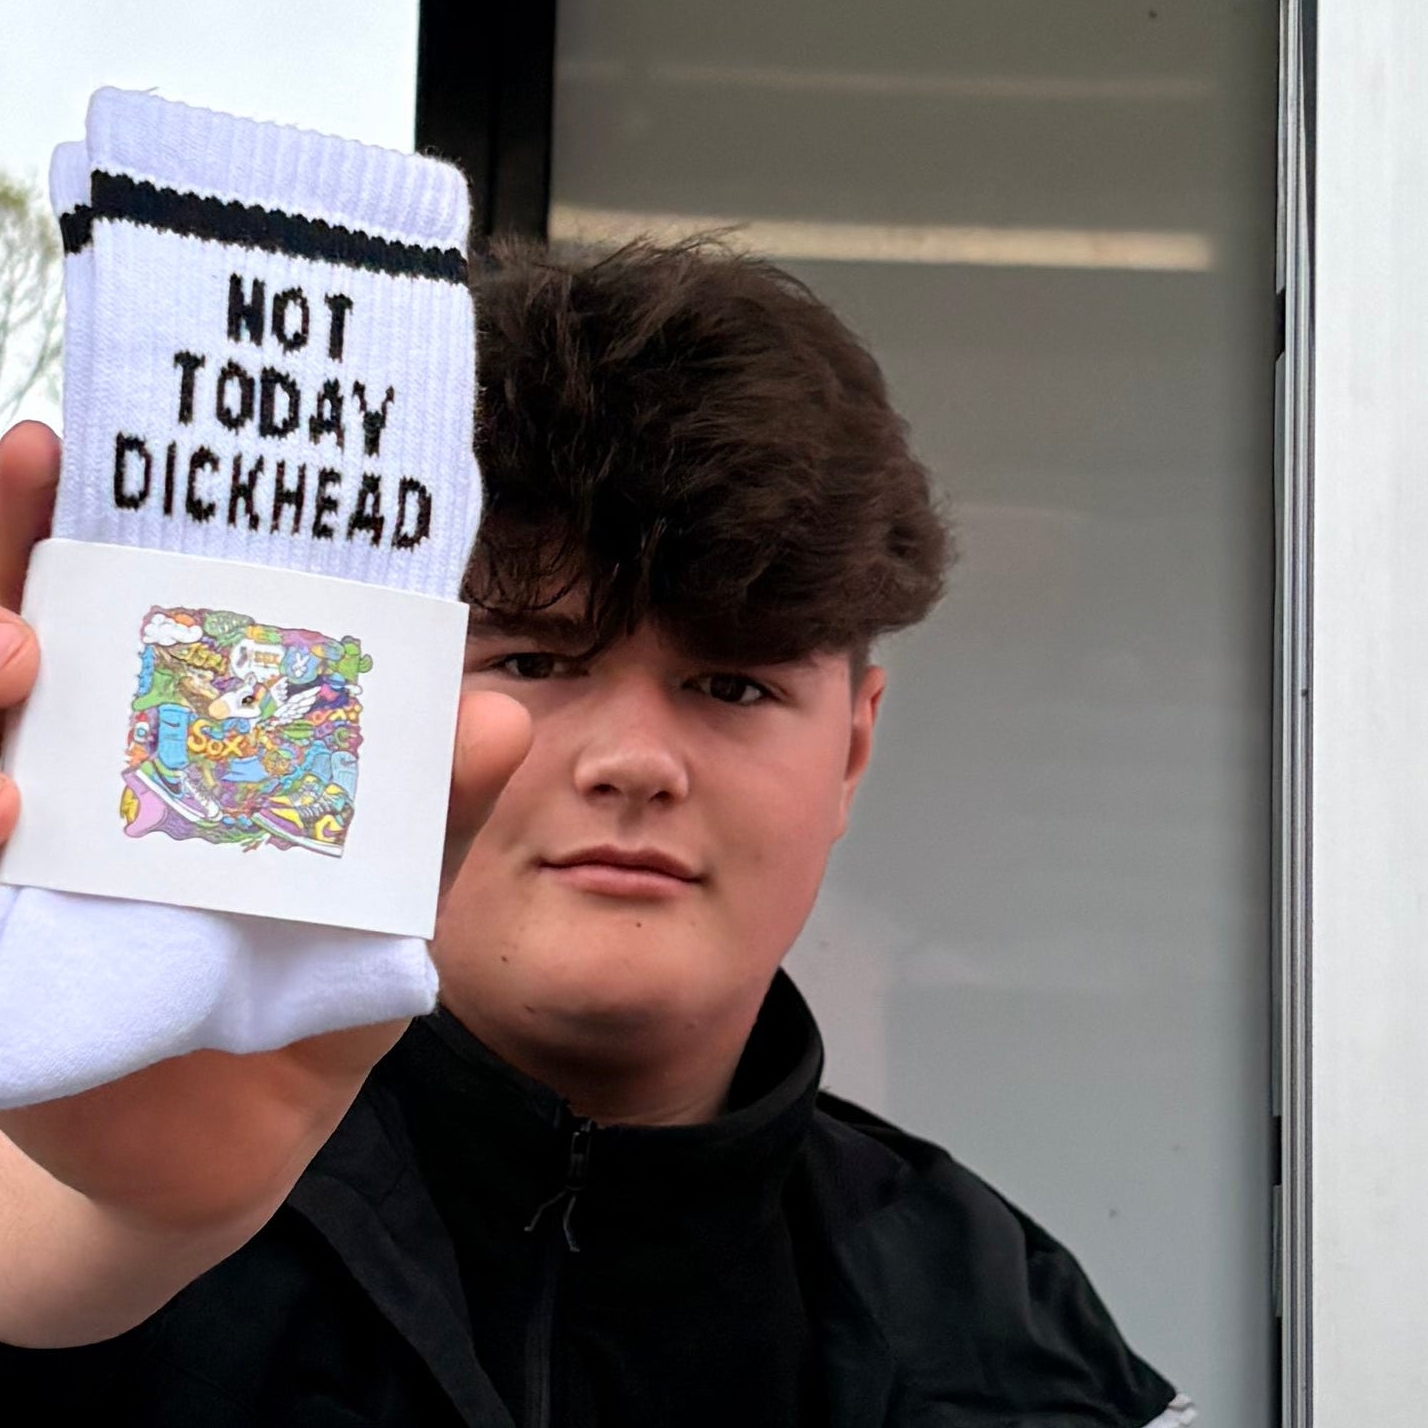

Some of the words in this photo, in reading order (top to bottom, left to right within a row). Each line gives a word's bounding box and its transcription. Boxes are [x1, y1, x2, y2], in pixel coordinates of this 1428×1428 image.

[227, 272, 353, 363] NOT
[173, 350, 395, 457] TODAY
[113, 431, 431, 552] DICKHEAD
